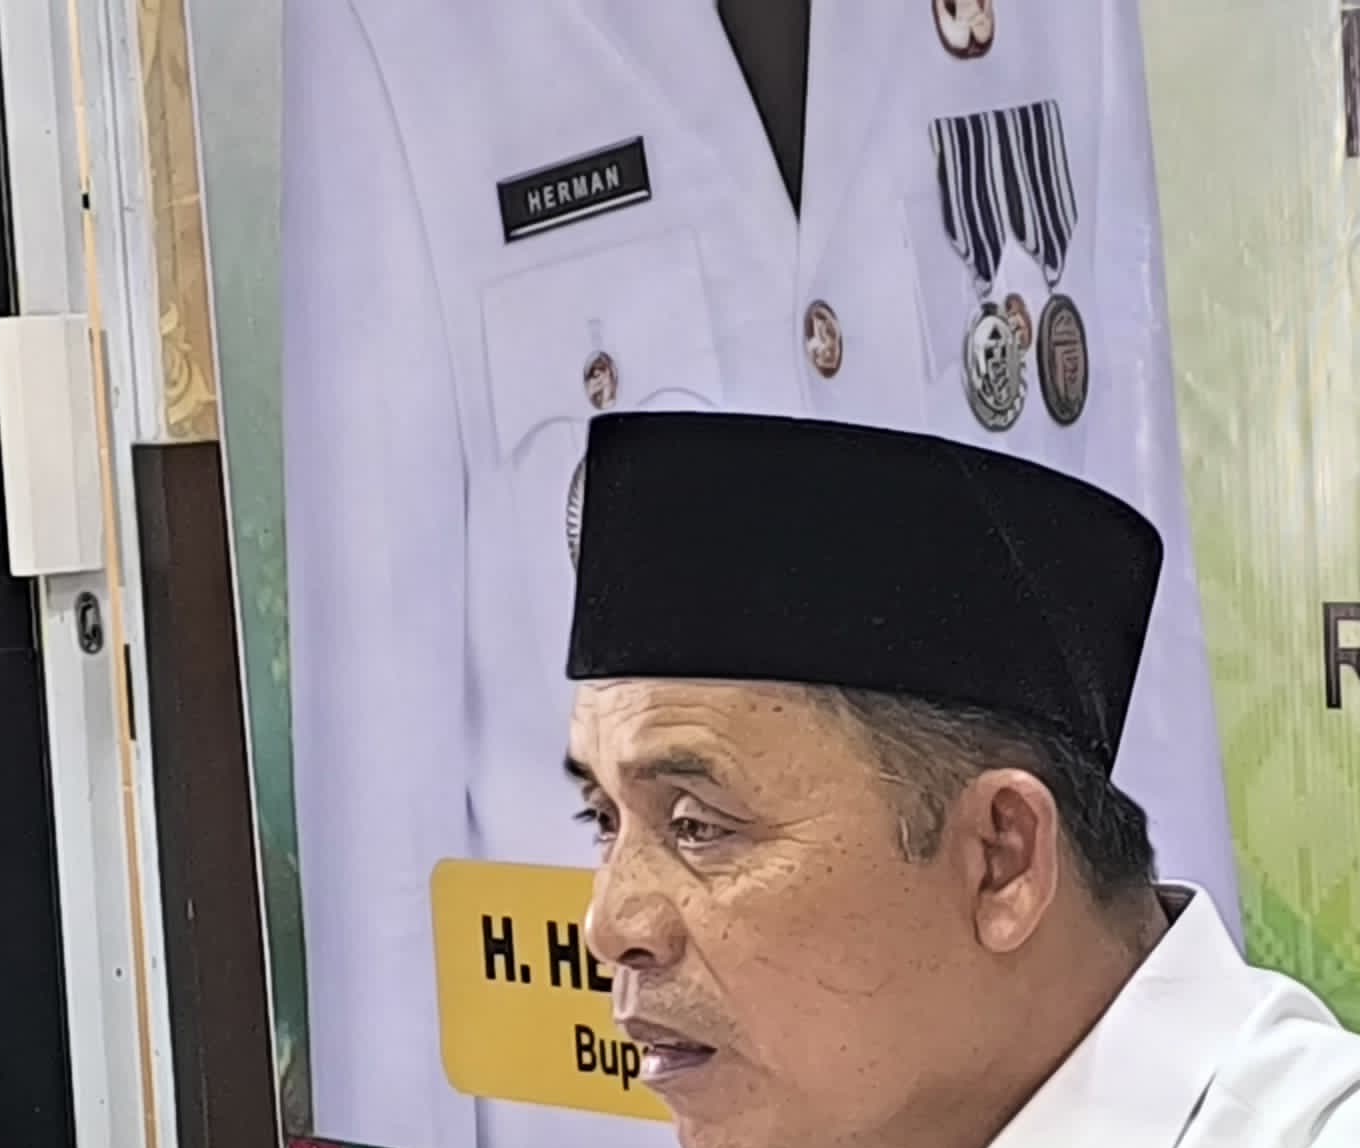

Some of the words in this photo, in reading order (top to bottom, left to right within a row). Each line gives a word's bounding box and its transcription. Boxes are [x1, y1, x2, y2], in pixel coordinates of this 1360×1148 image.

[527, 164, 620, 214] HERMAN
[481, 914, 531, 984] H.
[574, 1023, 649, 1091] Bup
